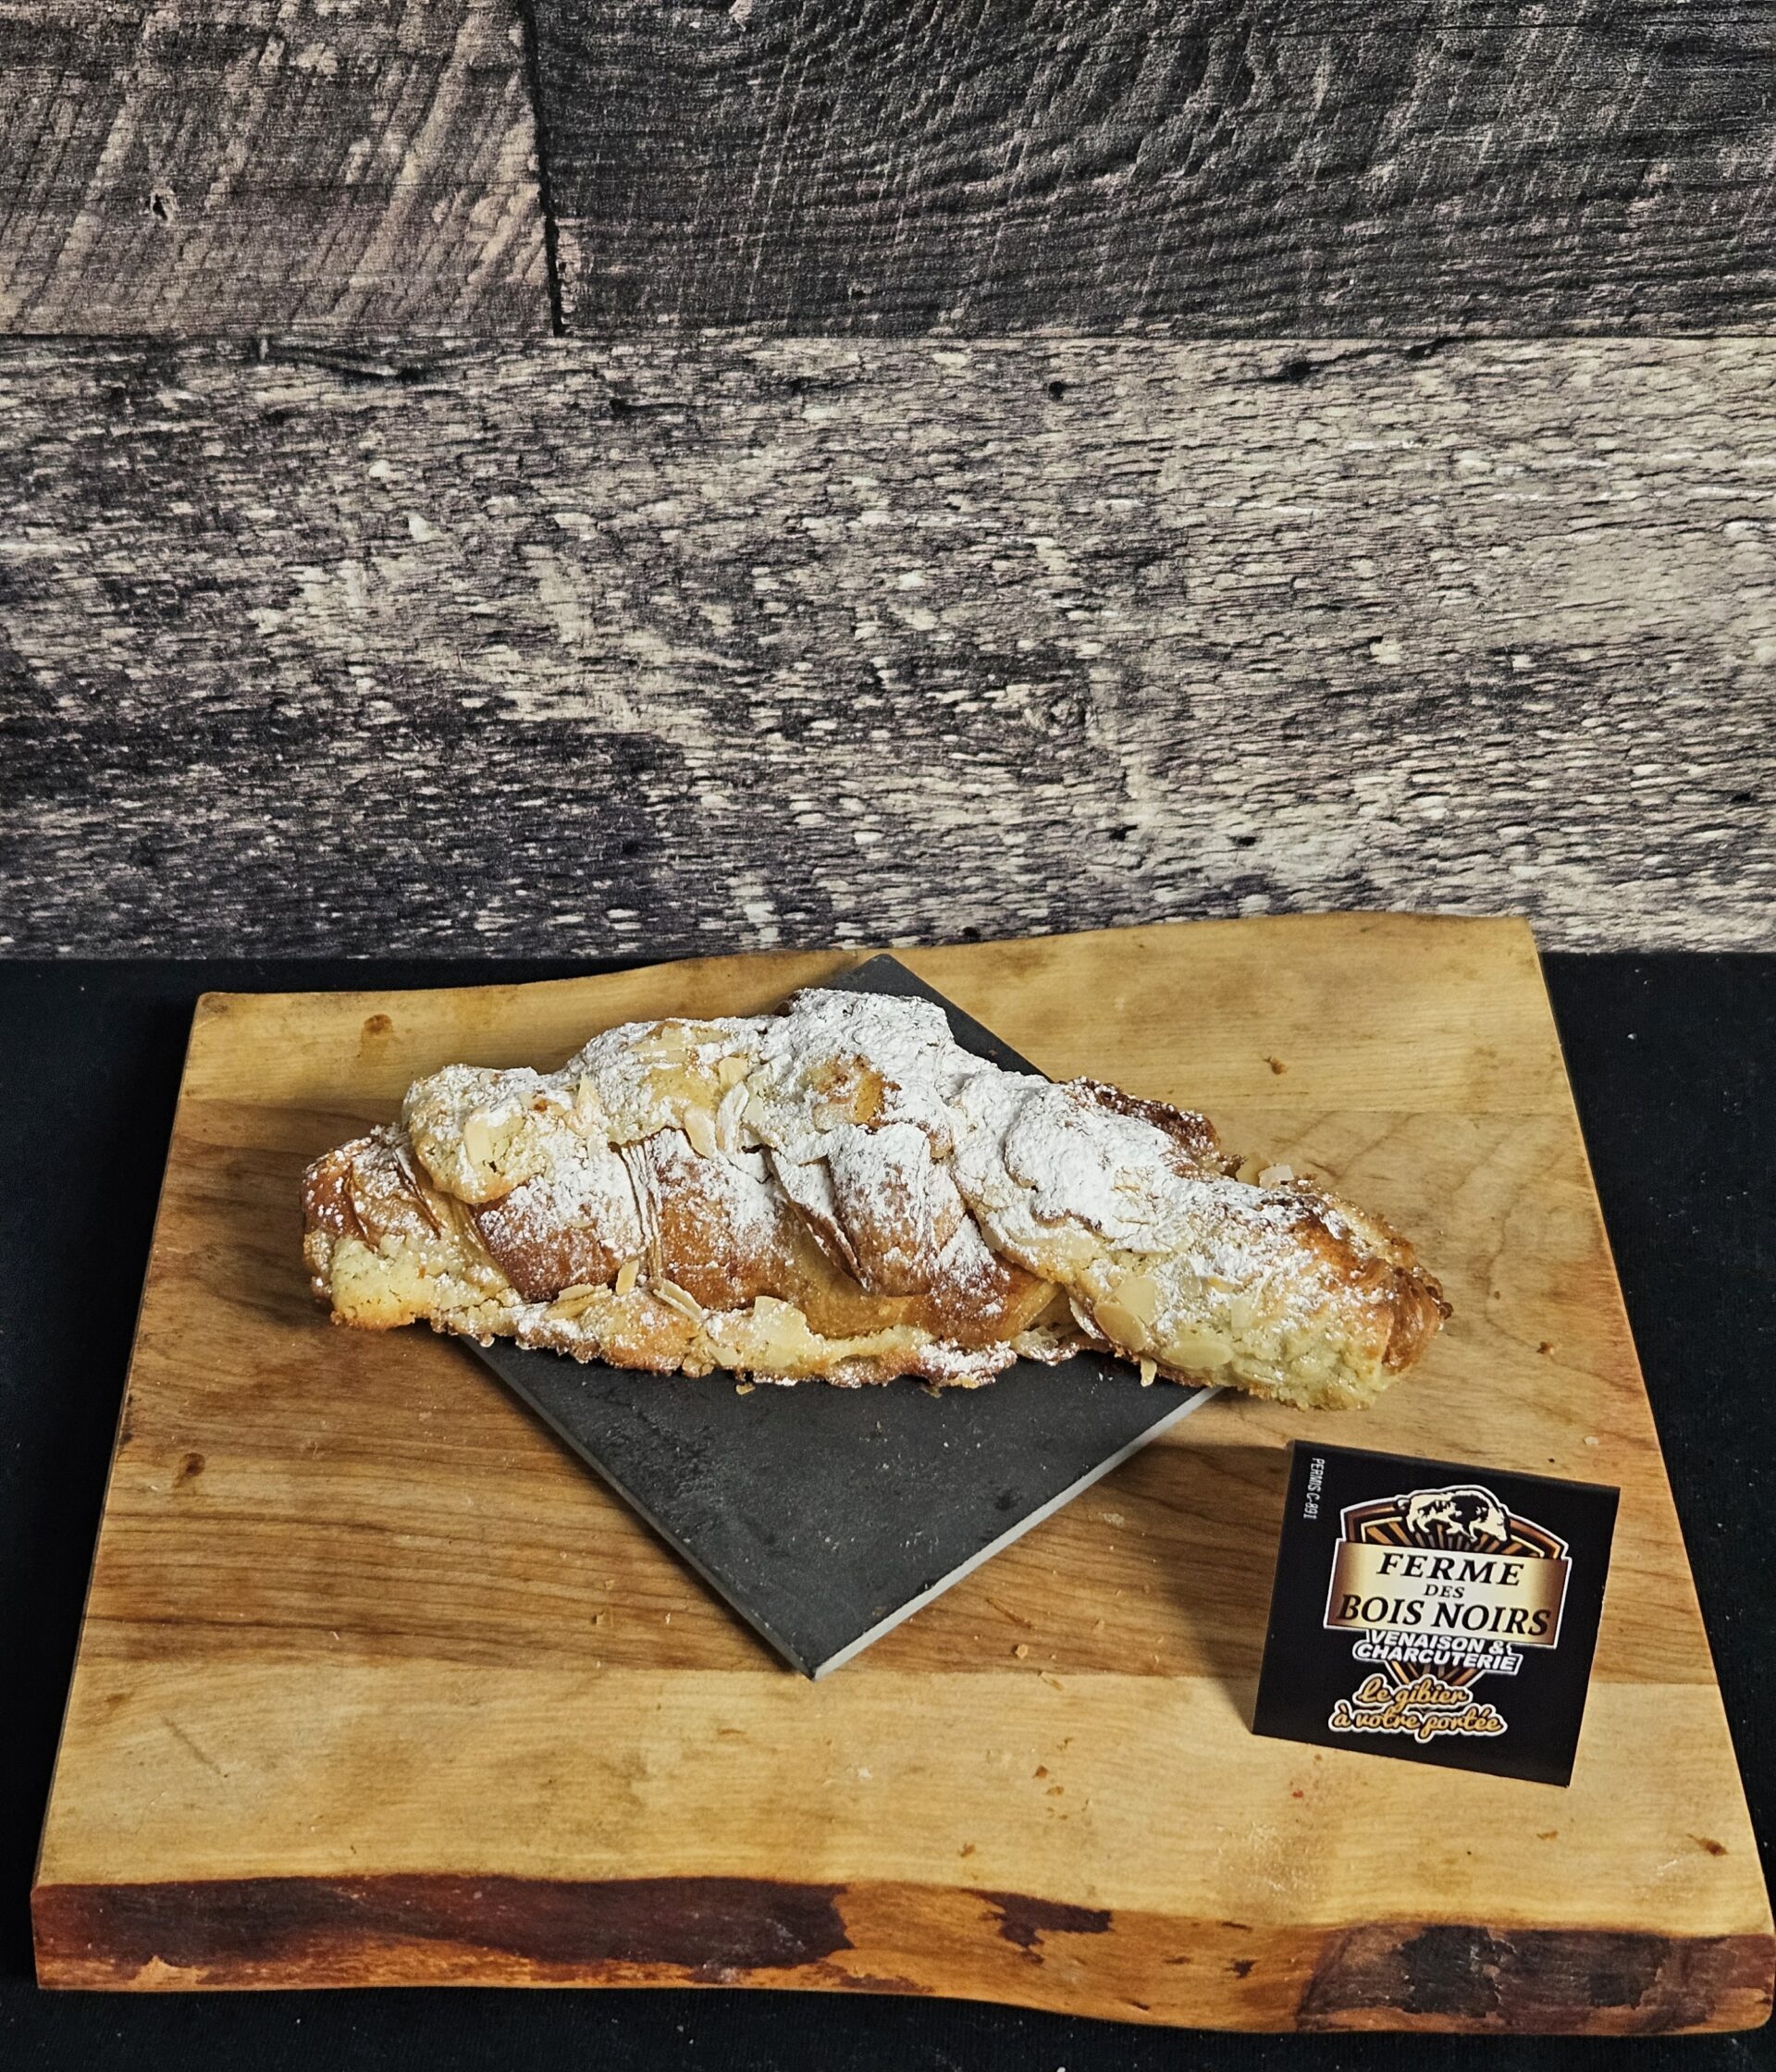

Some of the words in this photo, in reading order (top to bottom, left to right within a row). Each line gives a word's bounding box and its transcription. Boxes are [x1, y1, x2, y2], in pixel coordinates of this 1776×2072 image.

[1307, 1458, 1326, 1492] PERMIS
[1302, 1492, 1321, 1520] C-891
[1376, 1552, 1524, 1585] FERME
[1424, 1584, 1465, 1599] DES
[1336, 1594, 1424, 1626] BOIS
[1430, 1601, 1552, 1636] NOIRS
[1356, 1643, 1518, 1671] CHARCUTERIE
[1371, 1630, 1483, 1652] VENAISON
[1488, 1641, 1506, 1655] &
[1394, 1677, 1468, 1713] gibier
[1334, 1704, 1351, 1728] à
[1355, 1706, 1420, 1730] votre
[1420, 1706, 1502, 1739] portée
